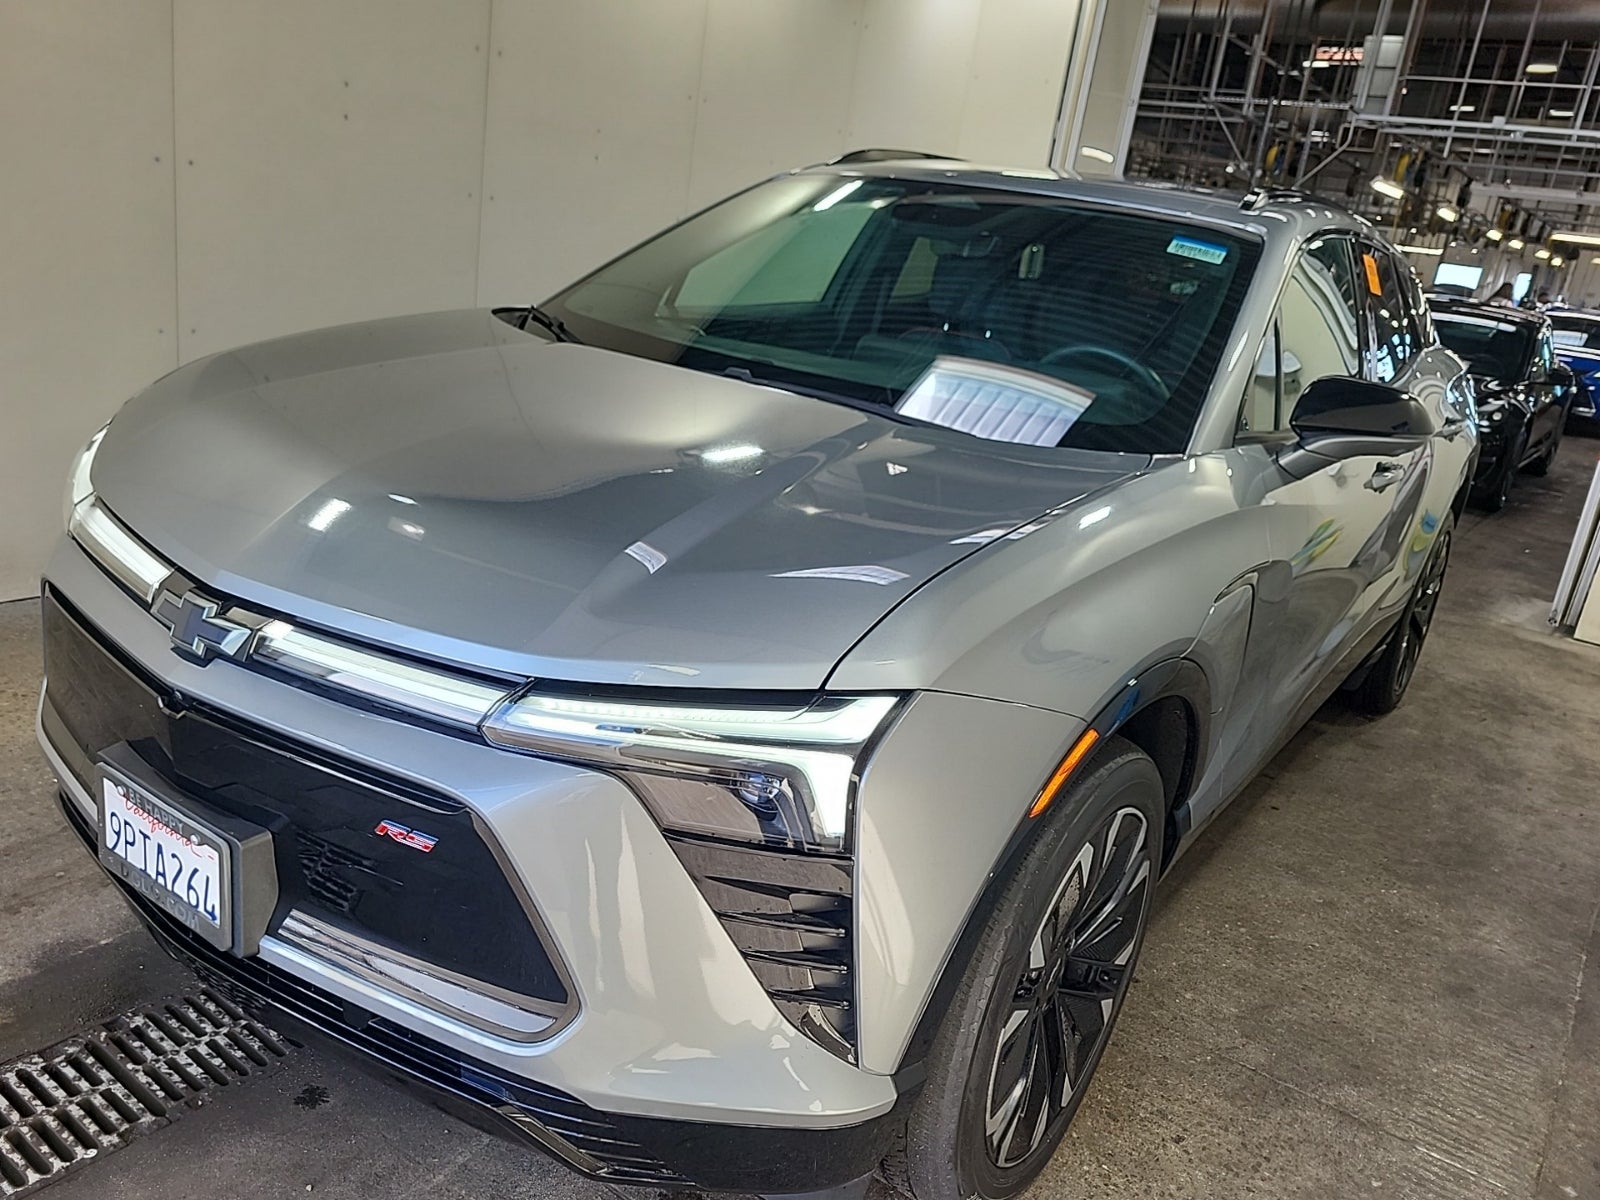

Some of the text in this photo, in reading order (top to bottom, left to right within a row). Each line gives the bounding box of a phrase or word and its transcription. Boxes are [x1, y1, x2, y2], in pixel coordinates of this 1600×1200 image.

[128, 788, 184, 835] BE HAPPY
[374, 819, 440, 853] RS
[110, 811, 218, 921] 9PIA264
